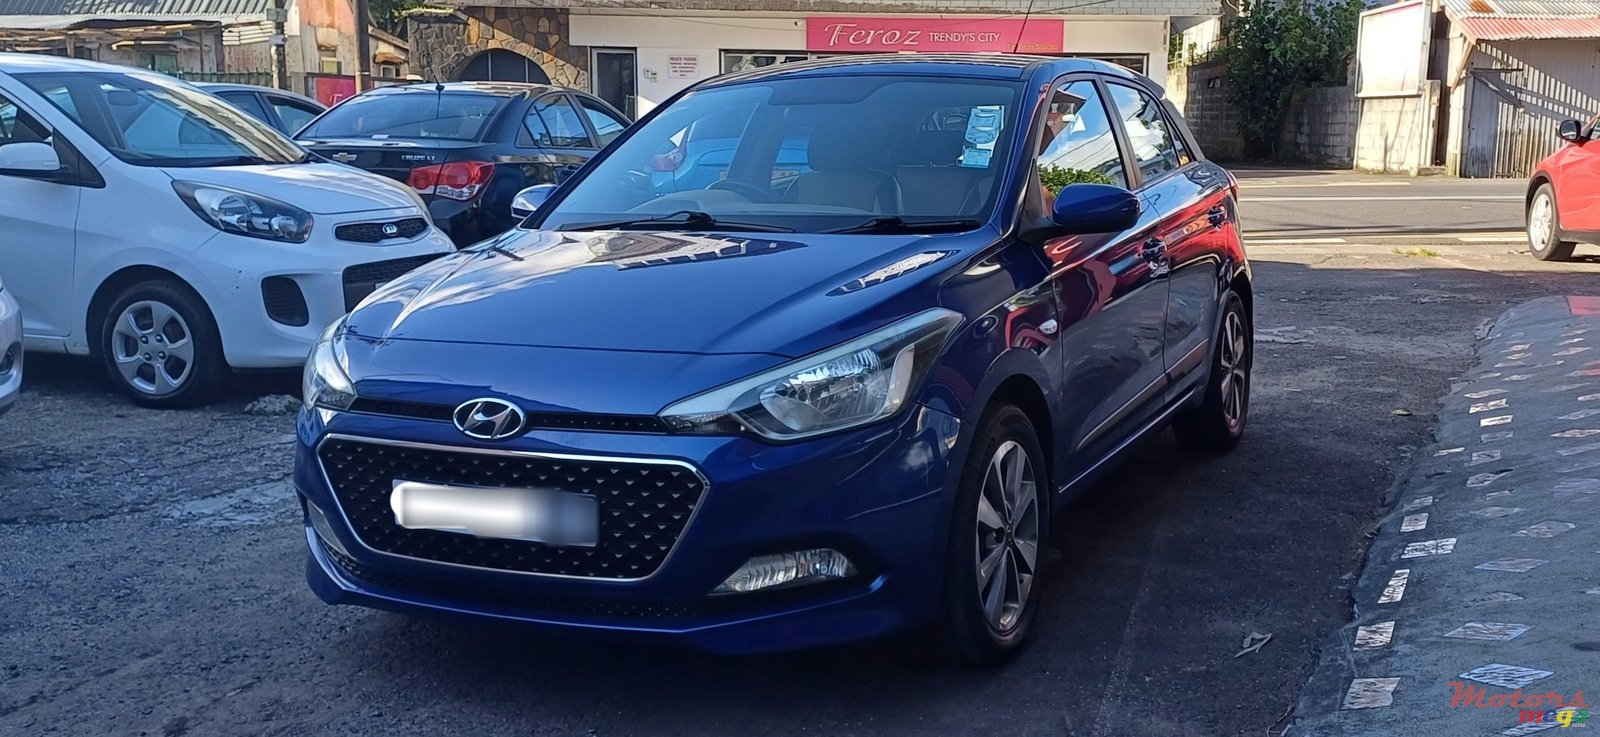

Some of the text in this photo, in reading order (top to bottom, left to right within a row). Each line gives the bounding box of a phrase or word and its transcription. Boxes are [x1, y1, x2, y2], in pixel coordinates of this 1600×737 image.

[824, 22, 1001, 46] Feroz TRENDY'S CITY
